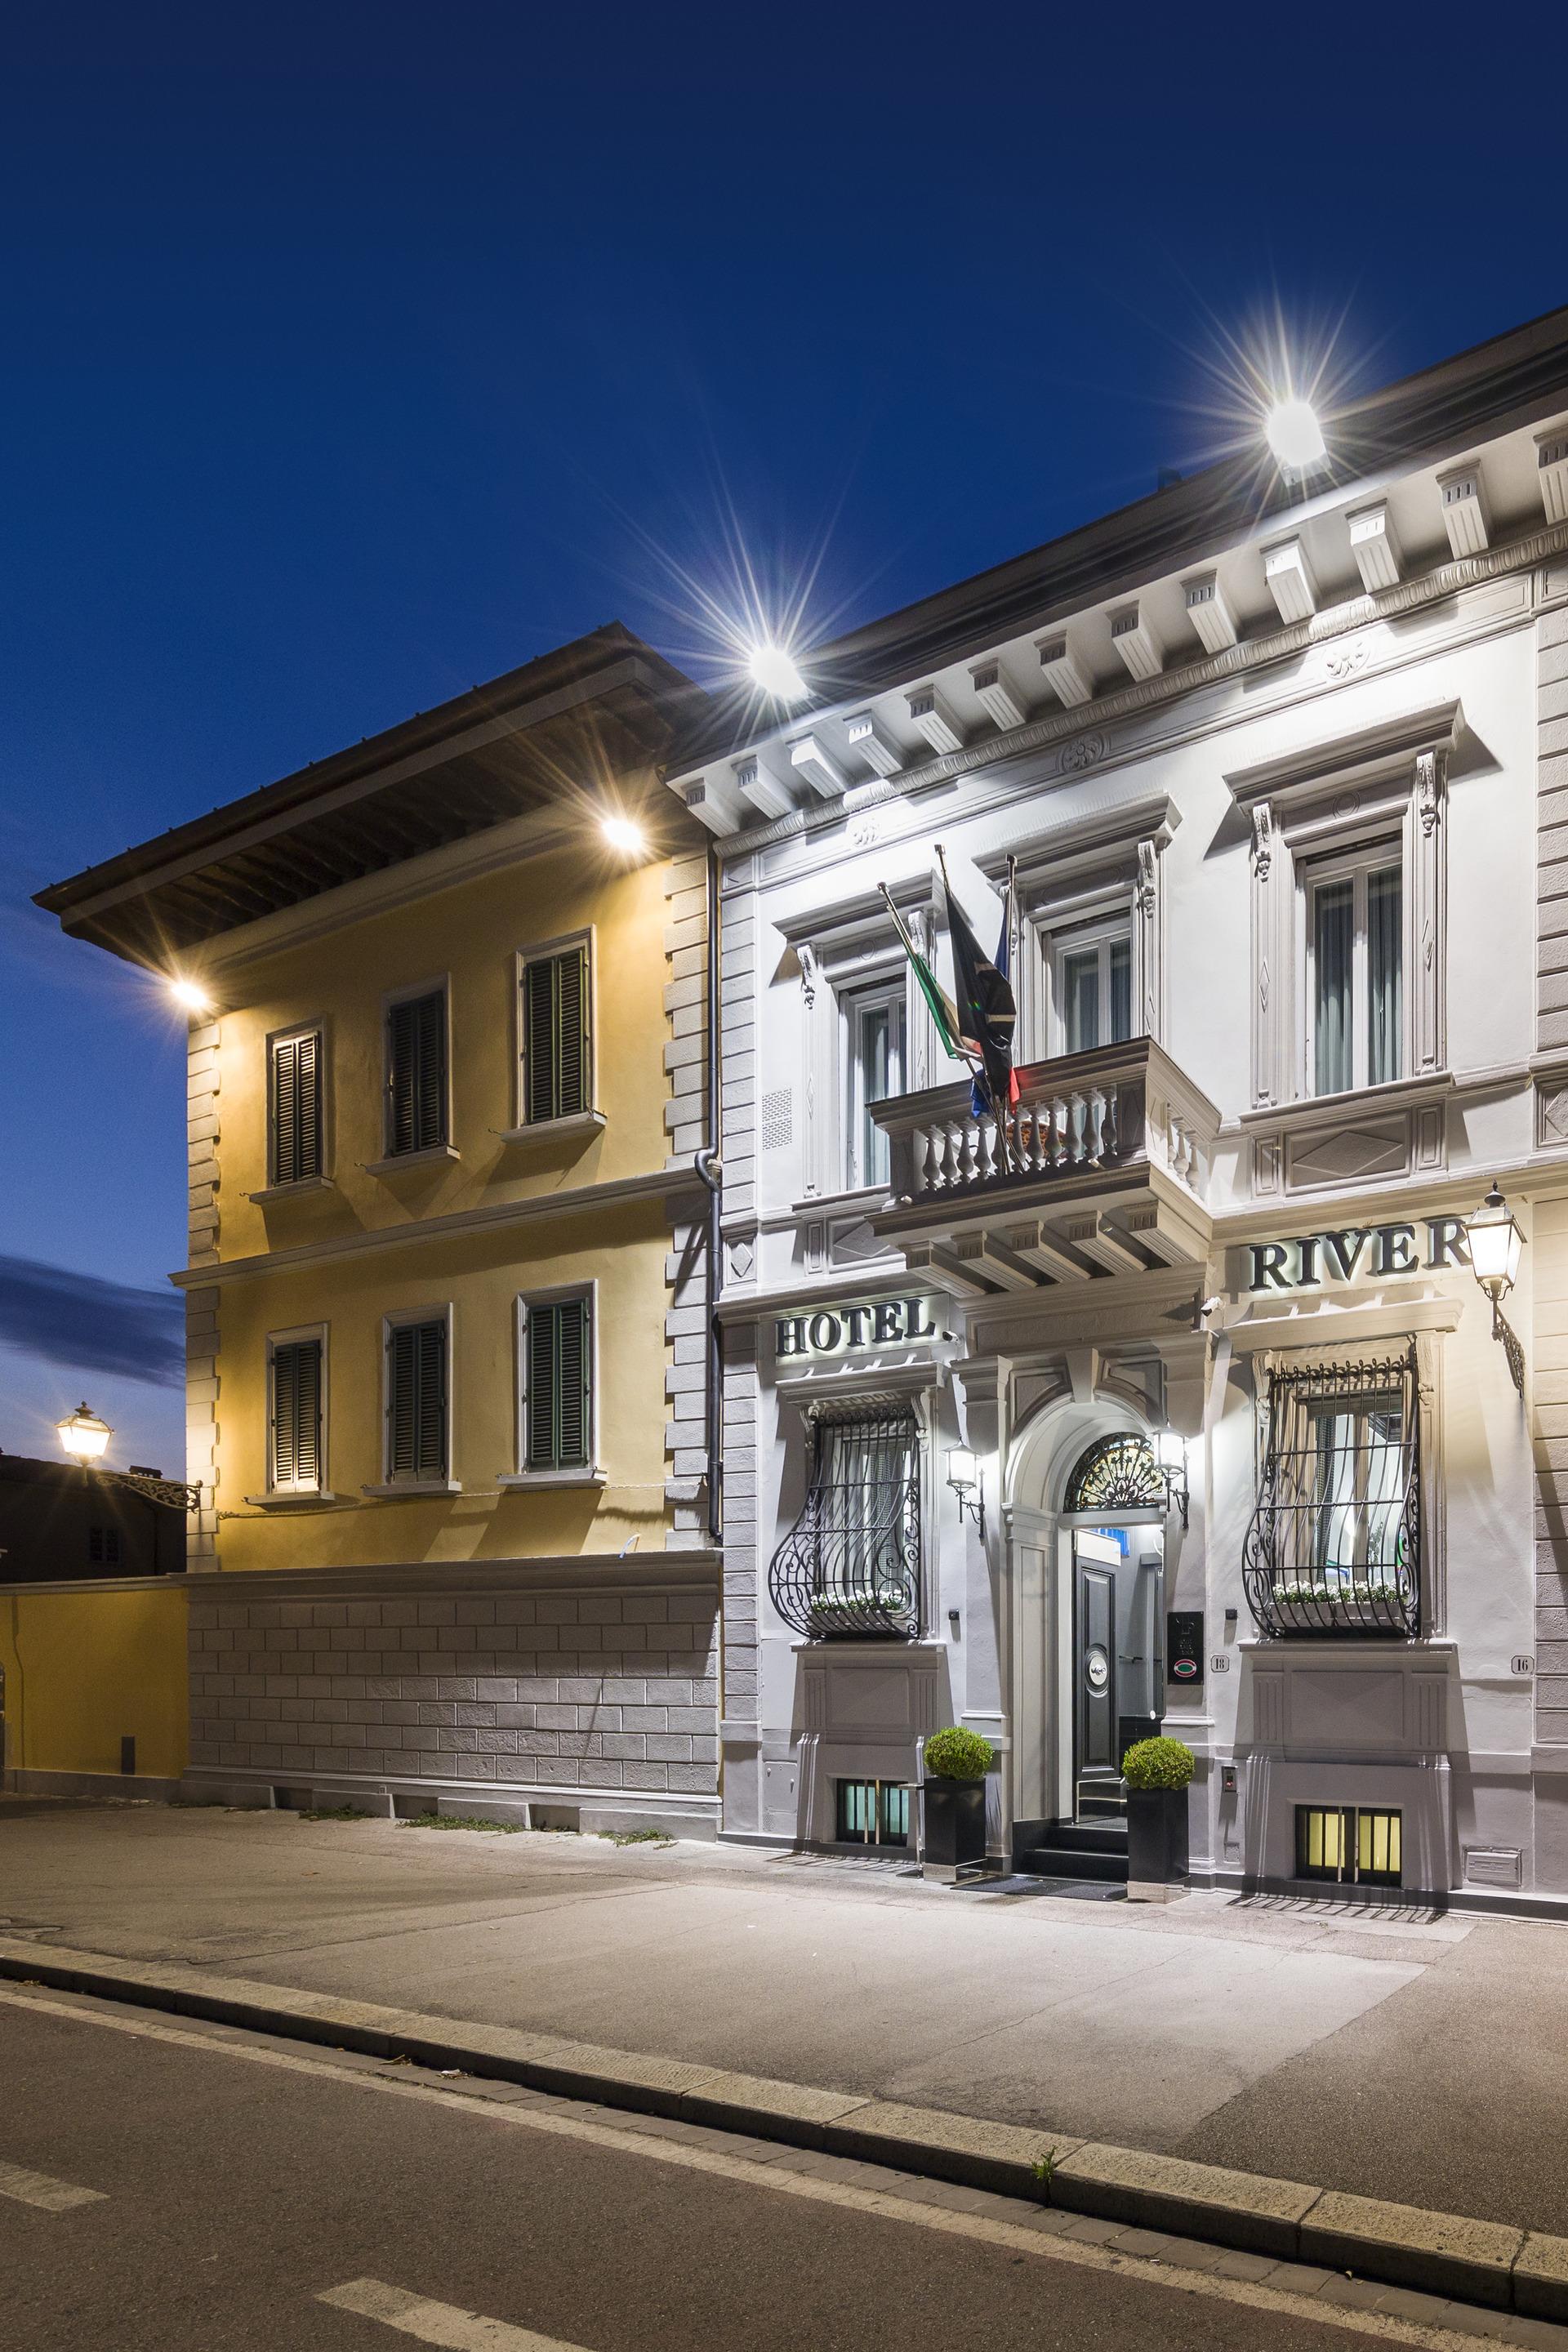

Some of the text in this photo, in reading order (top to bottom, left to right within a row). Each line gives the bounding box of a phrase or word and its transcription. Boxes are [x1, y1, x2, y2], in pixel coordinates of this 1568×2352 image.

[1249, 1217, 1472, 1292] RIVER
[775, 1298, 936, 1357] HOTEL
[1215, 1658, 1225, 1669] 18
[1517, 1659, 1529, 1671] 16
